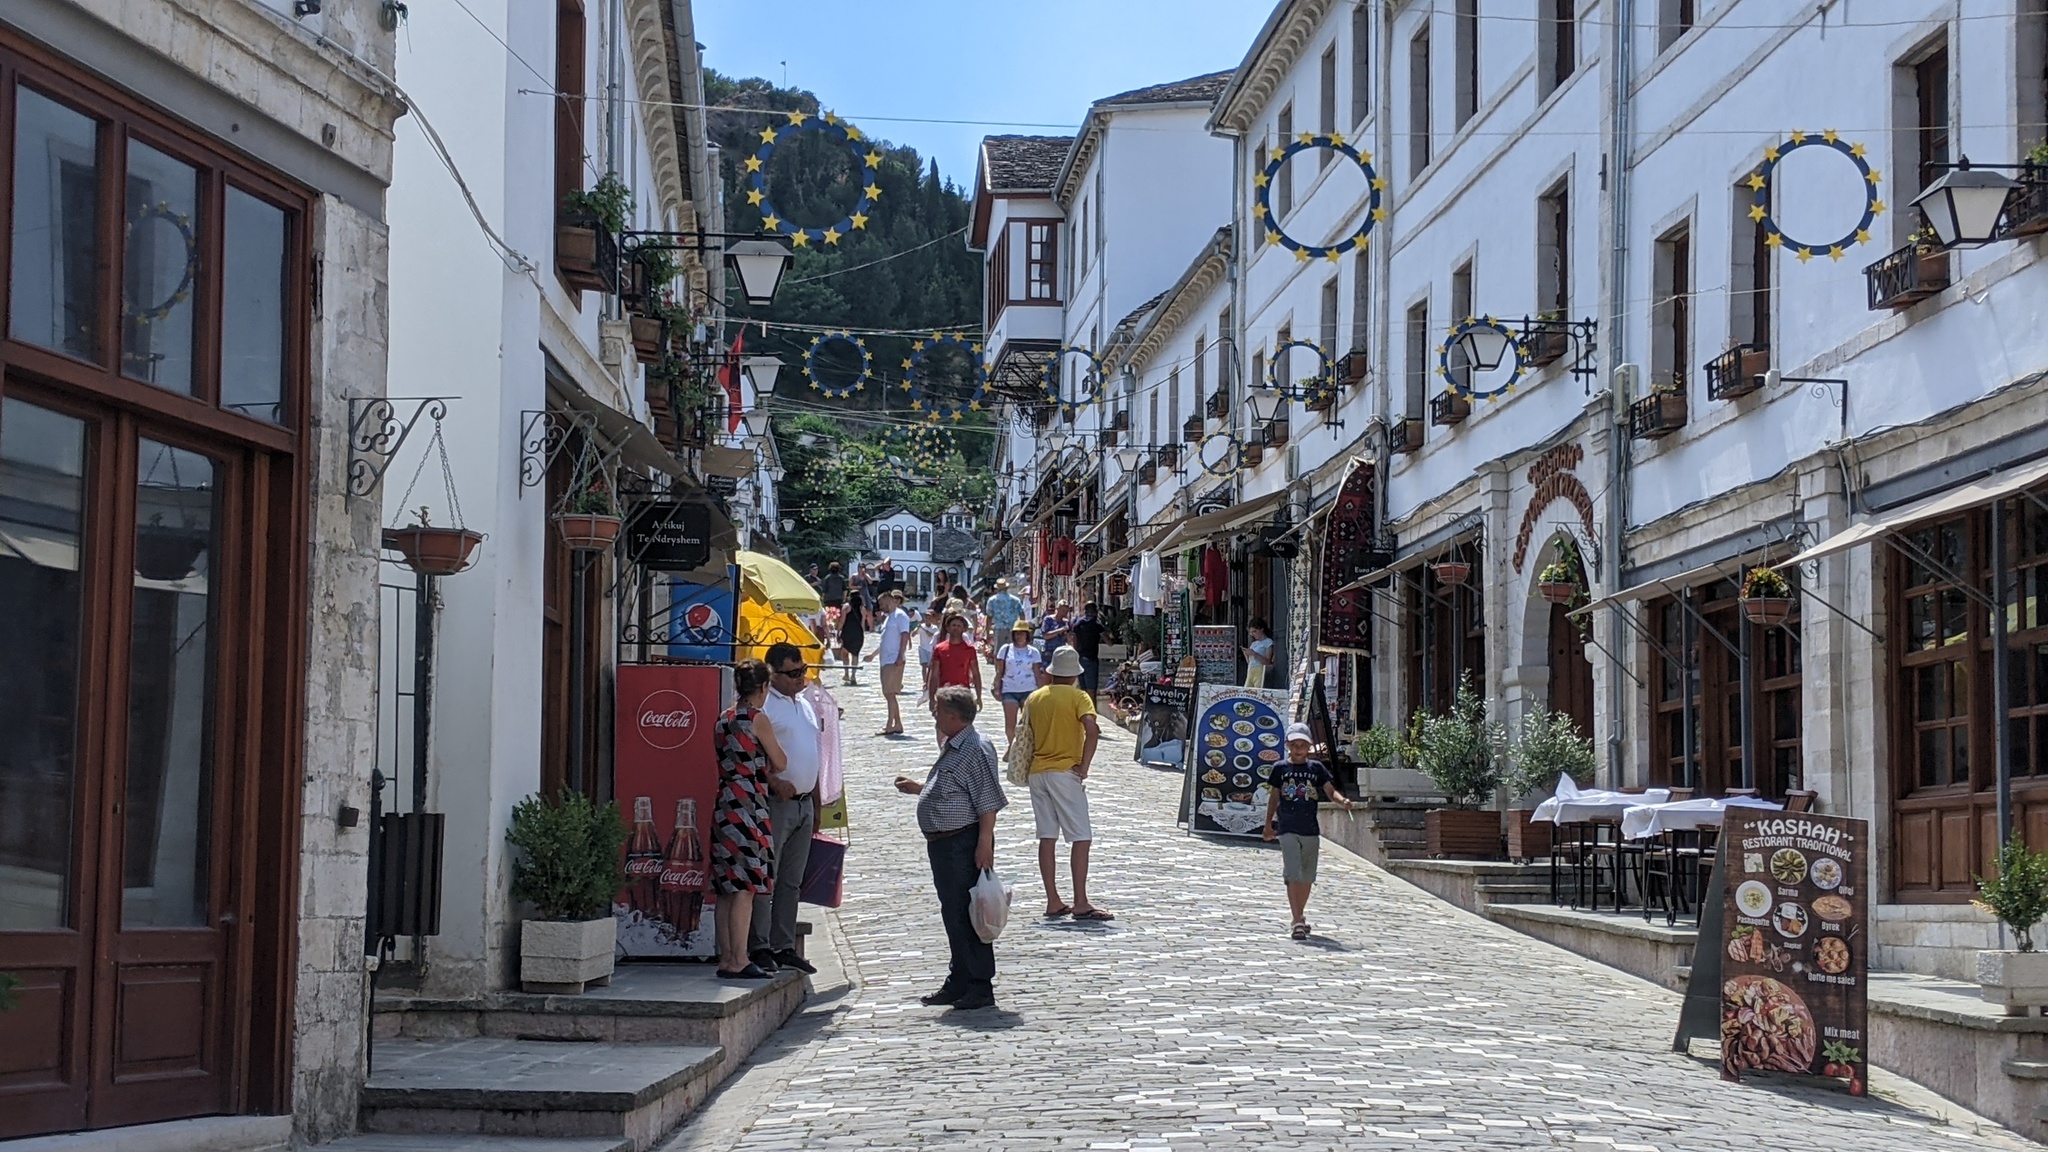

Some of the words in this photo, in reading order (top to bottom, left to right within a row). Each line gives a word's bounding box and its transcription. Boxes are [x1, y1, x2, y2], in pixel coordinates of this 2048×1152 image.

[637, 533, 650, 543] Te
[652, 534, 701, 547] Ndryshem
[1148, 686, 1187, 701] Jewelry
[640, 710, 693, 728] Coca-Cola
[1742, 836, 1795, 850] RESTORANT
[1795, 837, 1852, 862] TRADITIONAL
[624, 859, 663, 874] Coca-Cola
[659, 868, 705, 886] Coca-Cola
[1777, 887, 1799, 898] Sarma
[1821, 921, 1840, 932] Byrek
[1807, 972, 1826, 982] Qofte
[1826, 975, 1837, 983] me
[1824, 1026, 1838, 1037] Mix
[1839, 1029, 1860, 1040] meat
